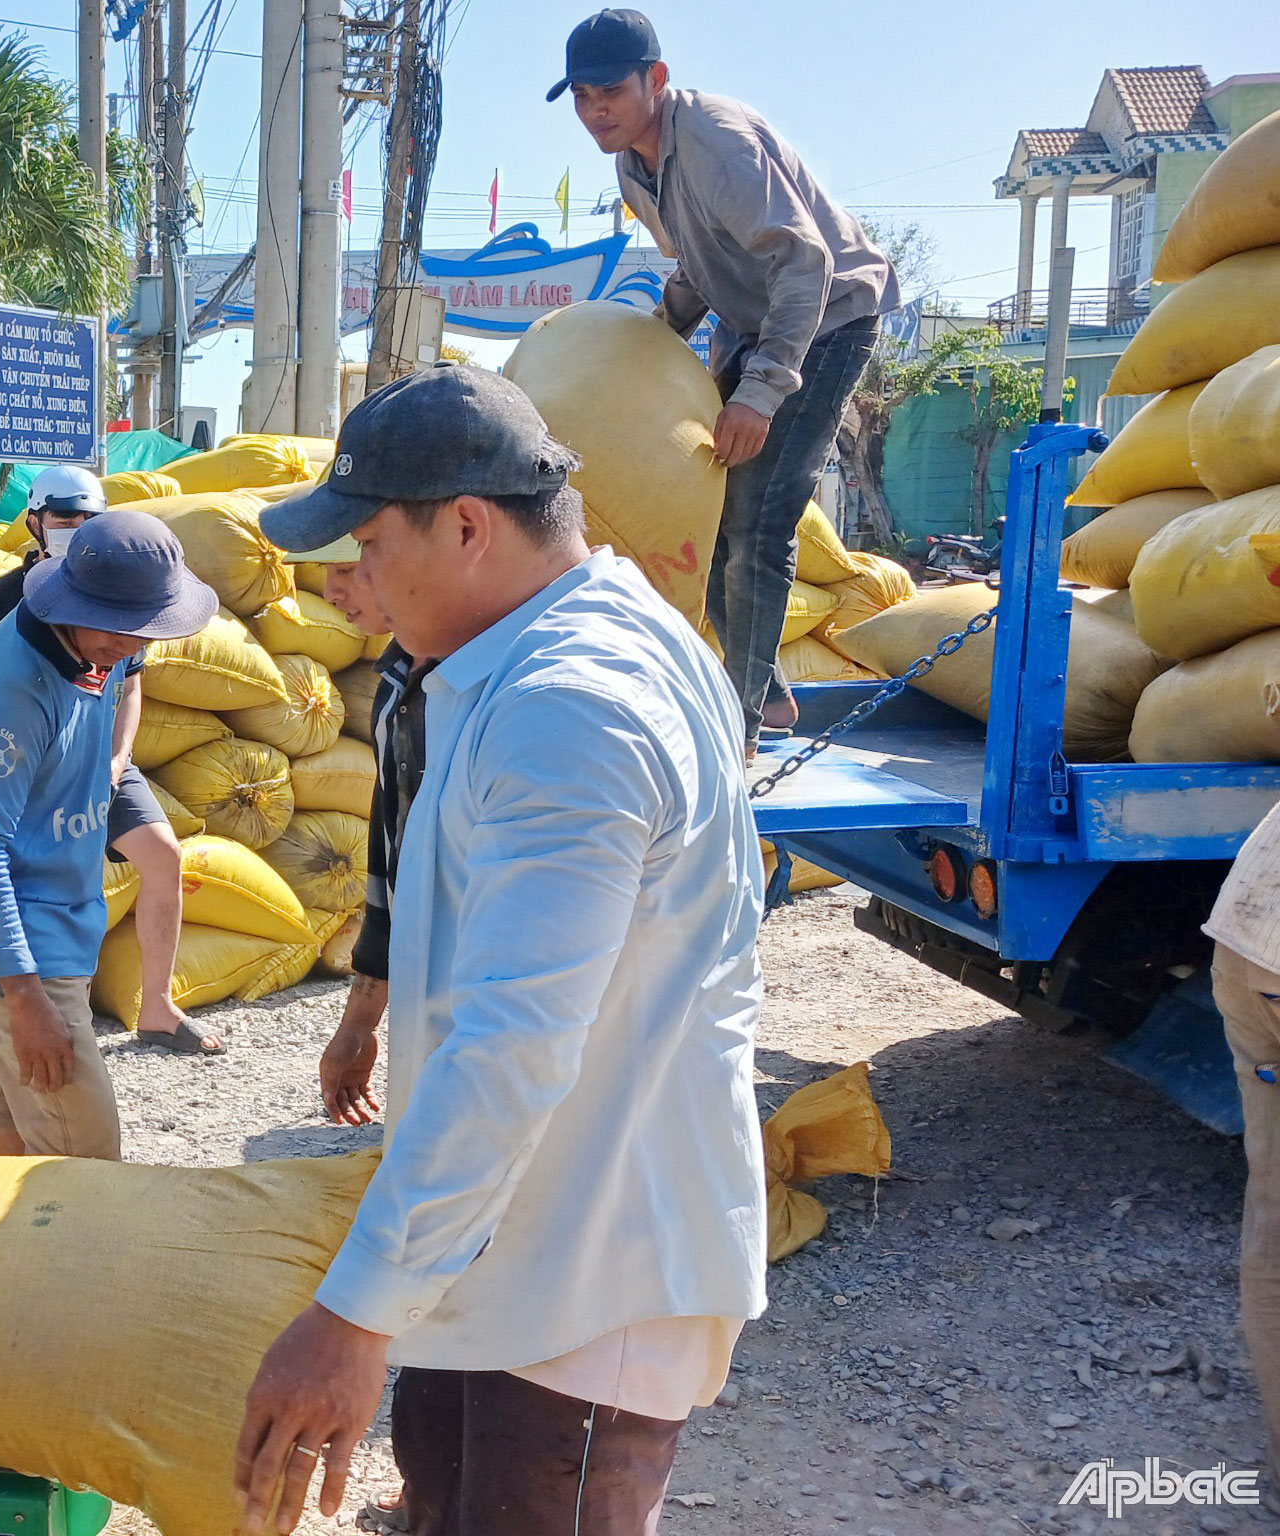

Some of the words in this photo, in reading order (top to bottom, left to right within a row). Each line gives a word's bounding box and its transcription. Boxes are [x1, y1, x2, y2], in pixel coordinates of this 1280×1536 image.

[450, 280, 504, 307] VÀM
[510, 279, 572, 306] LÁNG
[5, 317, 23, 339] CẤM
[24, 325, 40, 343] MỌI
[41, 321, 51, 342] TỔ
[1, 341, 17, 361] SẢN
[18, 343, 42, 366] XUẤT,
[43, 348, 64, 367] BUÔN
[65, 350, 82, 370] BÁN,
[1, 366, 18, 387] VẬN
[19, 366, 51, 388] CHUYỂN
[52, 372, 70, 390] TRÁI
[71, 374, 90, 391] PHÉP
[9, 388, 30, 409] CHẤT
[46, 396, 67, 412] XUNG
[11, 416, 33, 431] KHAI
[33, 415, 54, 433] THÁC
[76, 416, 91, 436] SẢN
[1, 433, 13, 453] CẢ
[14, 435, 30, 454] CÁC
[31, 437, 53, 456] VÙNG
[54, 439, 75, 457] NƯỚC
